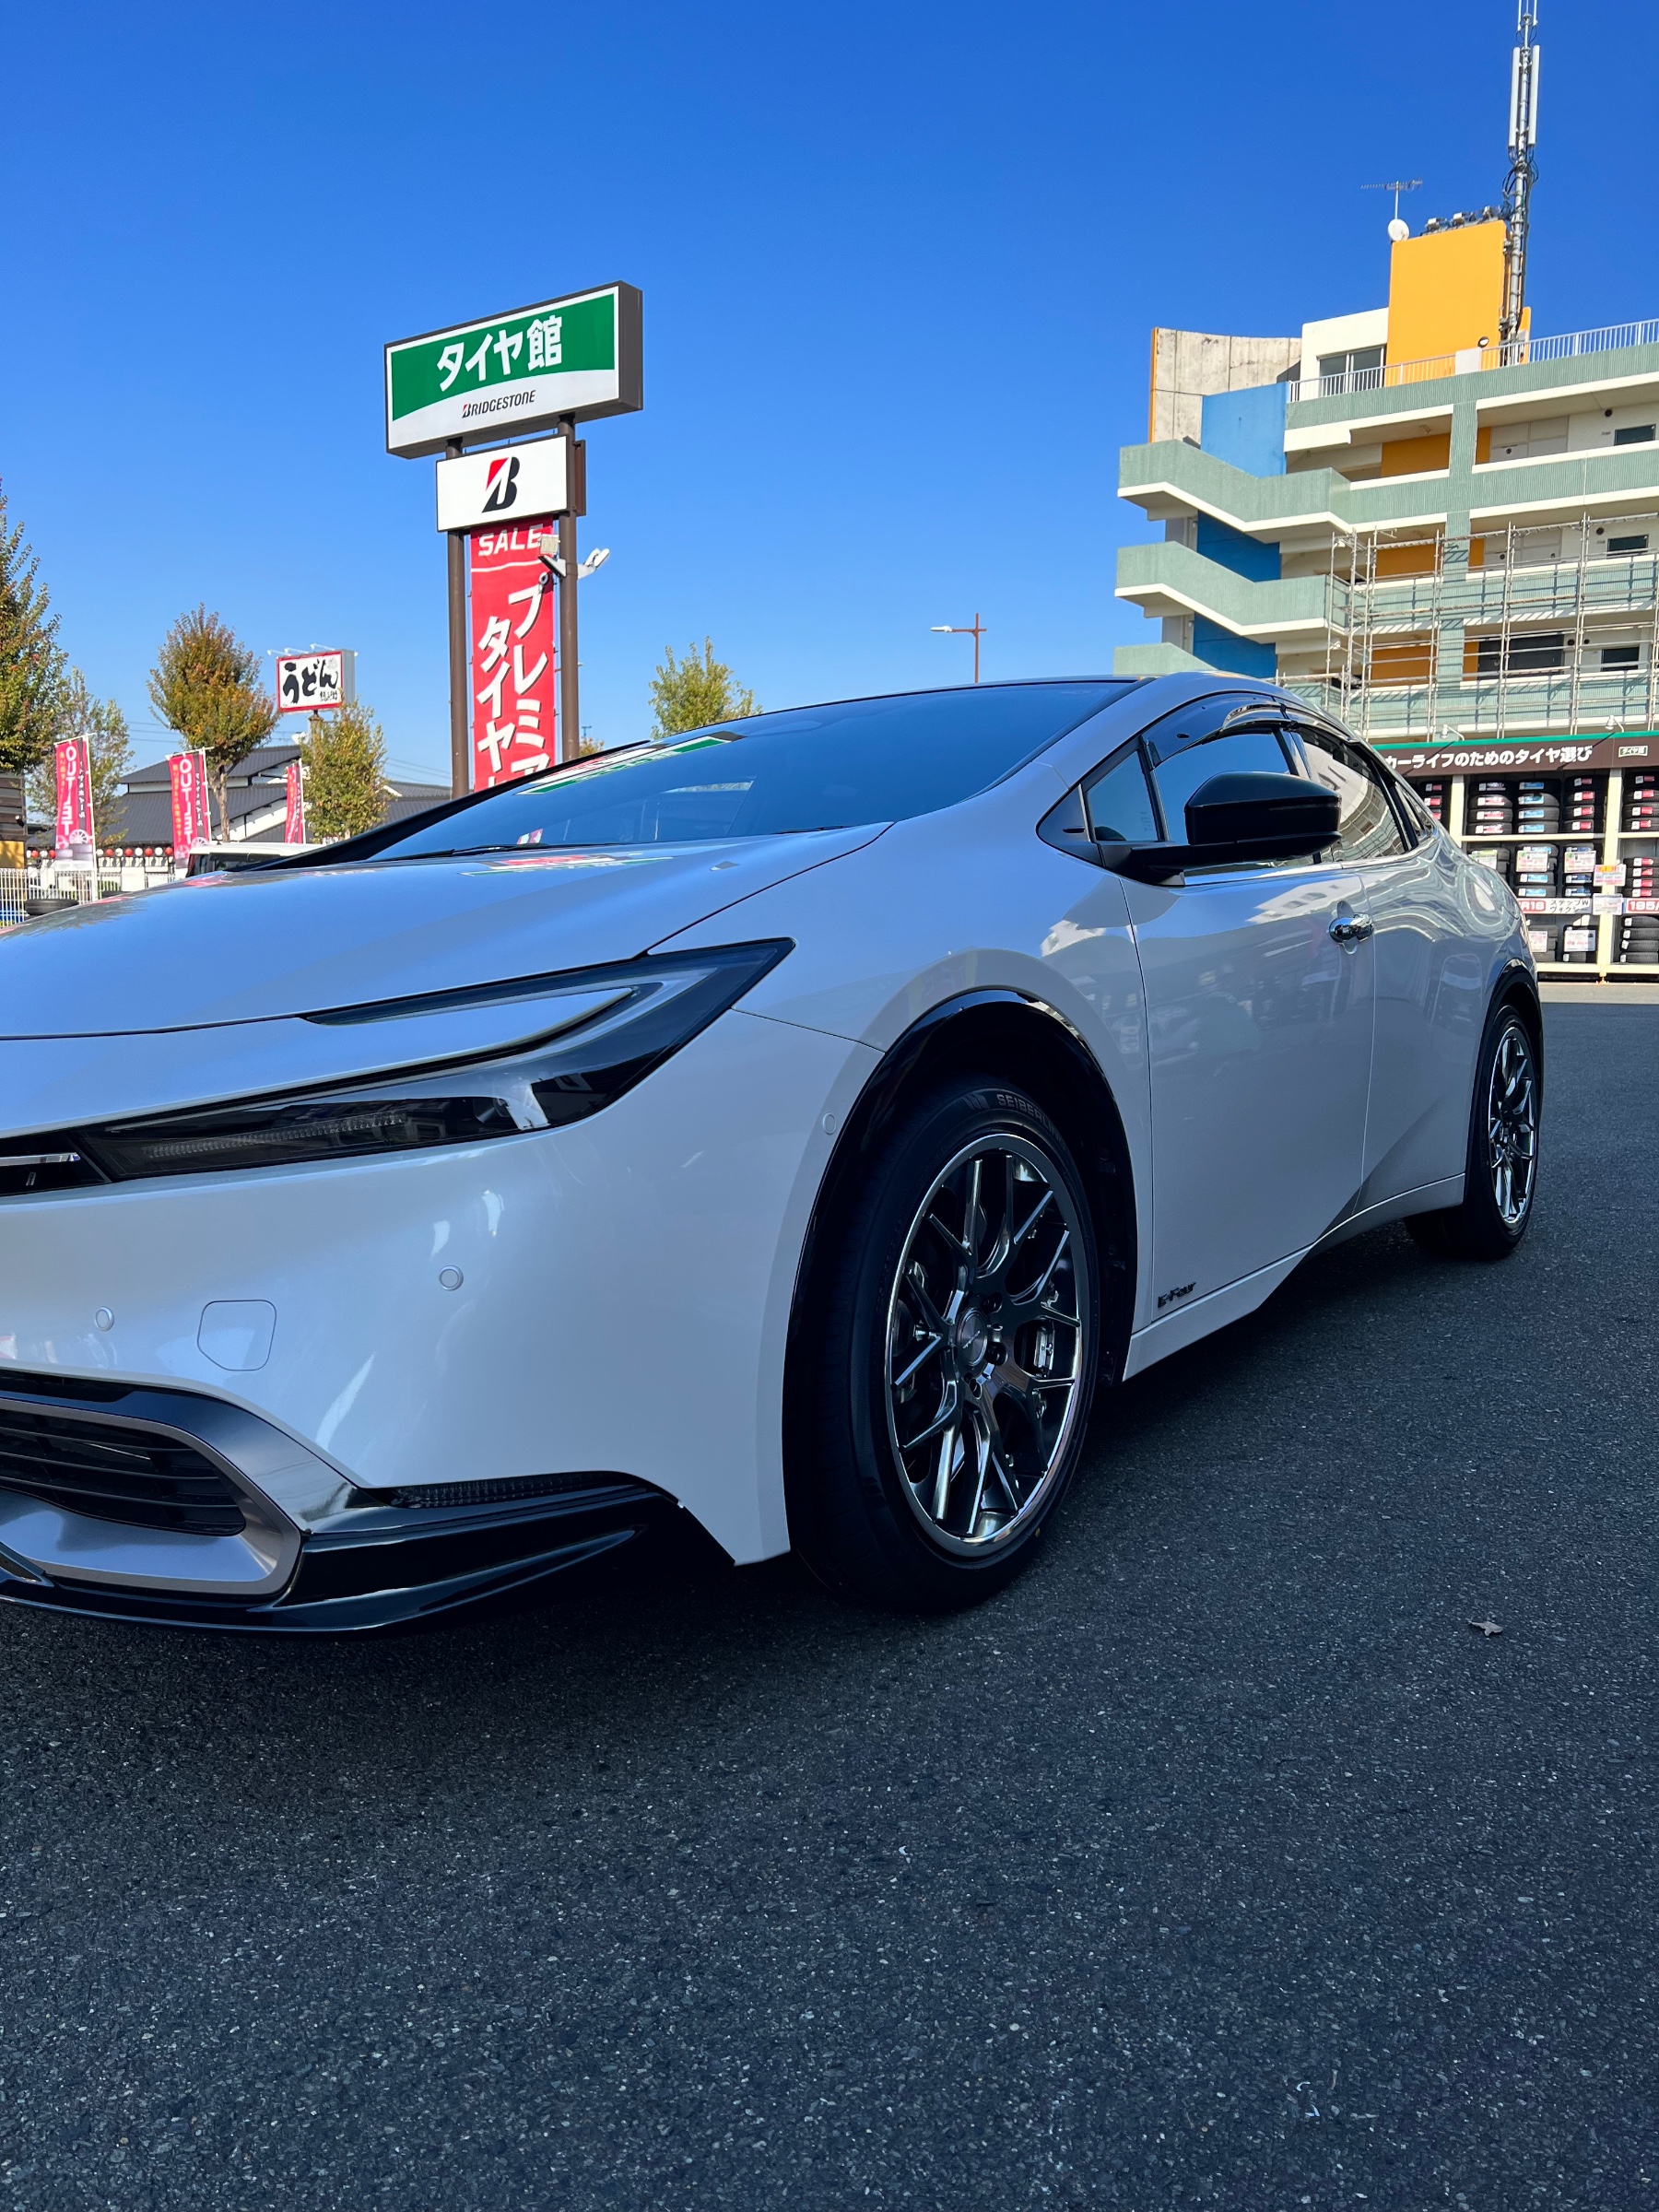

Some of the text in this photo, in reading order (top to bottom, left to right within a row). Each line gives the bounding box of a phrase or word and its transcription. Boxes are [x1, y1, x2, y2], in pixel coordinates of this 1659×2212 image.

[437, 315, 562, 392] タイヤ館
[462, 390, 535, 418] BRIDGESTONE
[478, 524, 543, 557] SALE
[283, 658, 339, 704] うどん
[476, 615, 516, 787] タイヤ
[61, 746, 77, 836] OUTLET
[179, 759, 194, 845] OUTLET
